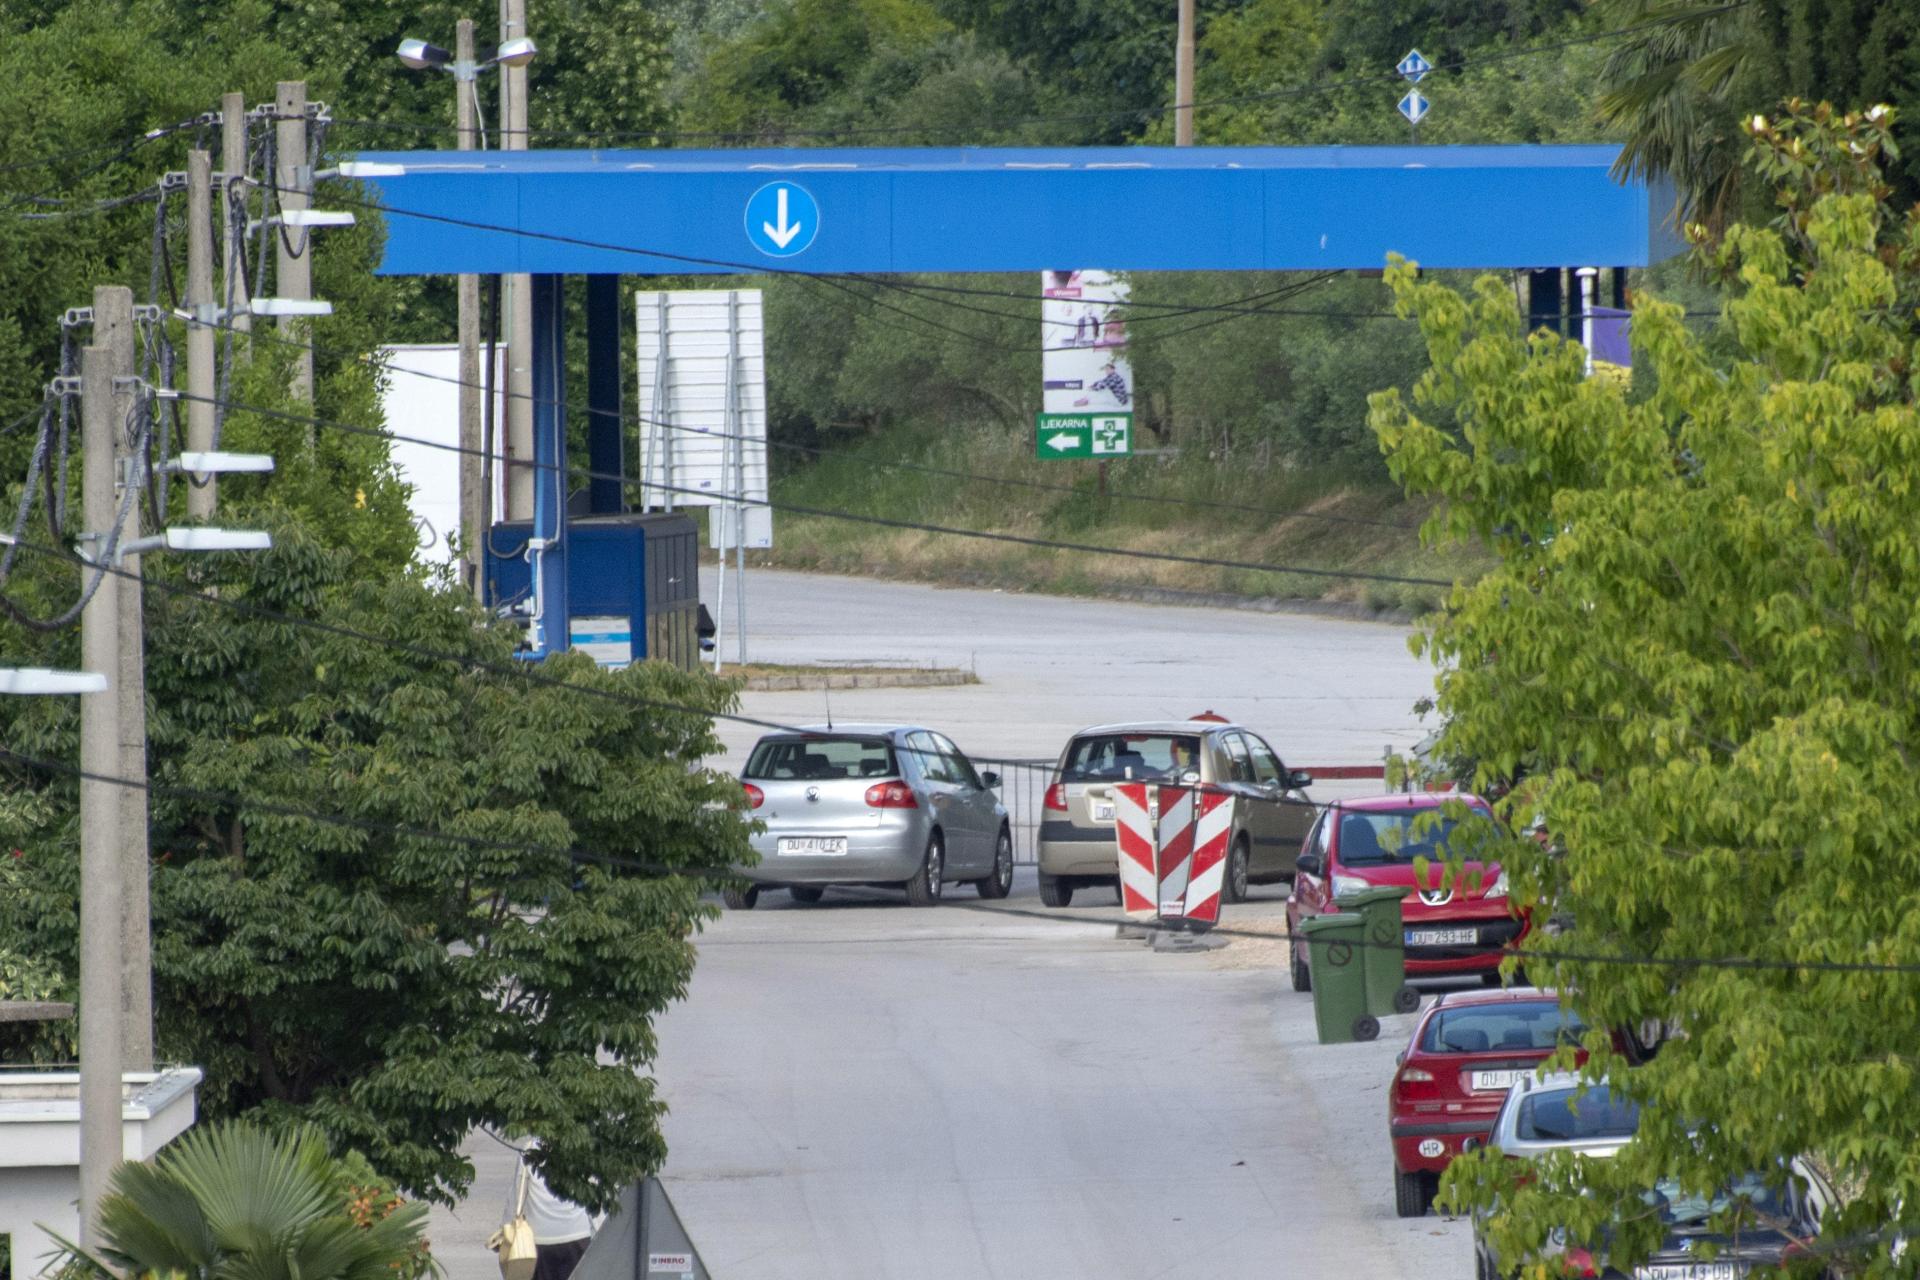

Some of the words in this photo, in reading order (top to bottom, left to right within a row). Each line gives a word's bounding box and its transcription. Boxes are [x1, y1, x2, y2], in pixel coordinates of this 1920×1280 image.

[1040, 418, 1088, 429] LJEKARNA
[787, 839, 800, 850] DU
[1413, 933, 1427, 945] DU
[1423, 1141, 1440, 1156] HR
[1652, 1267, 1669, 1280] DU
